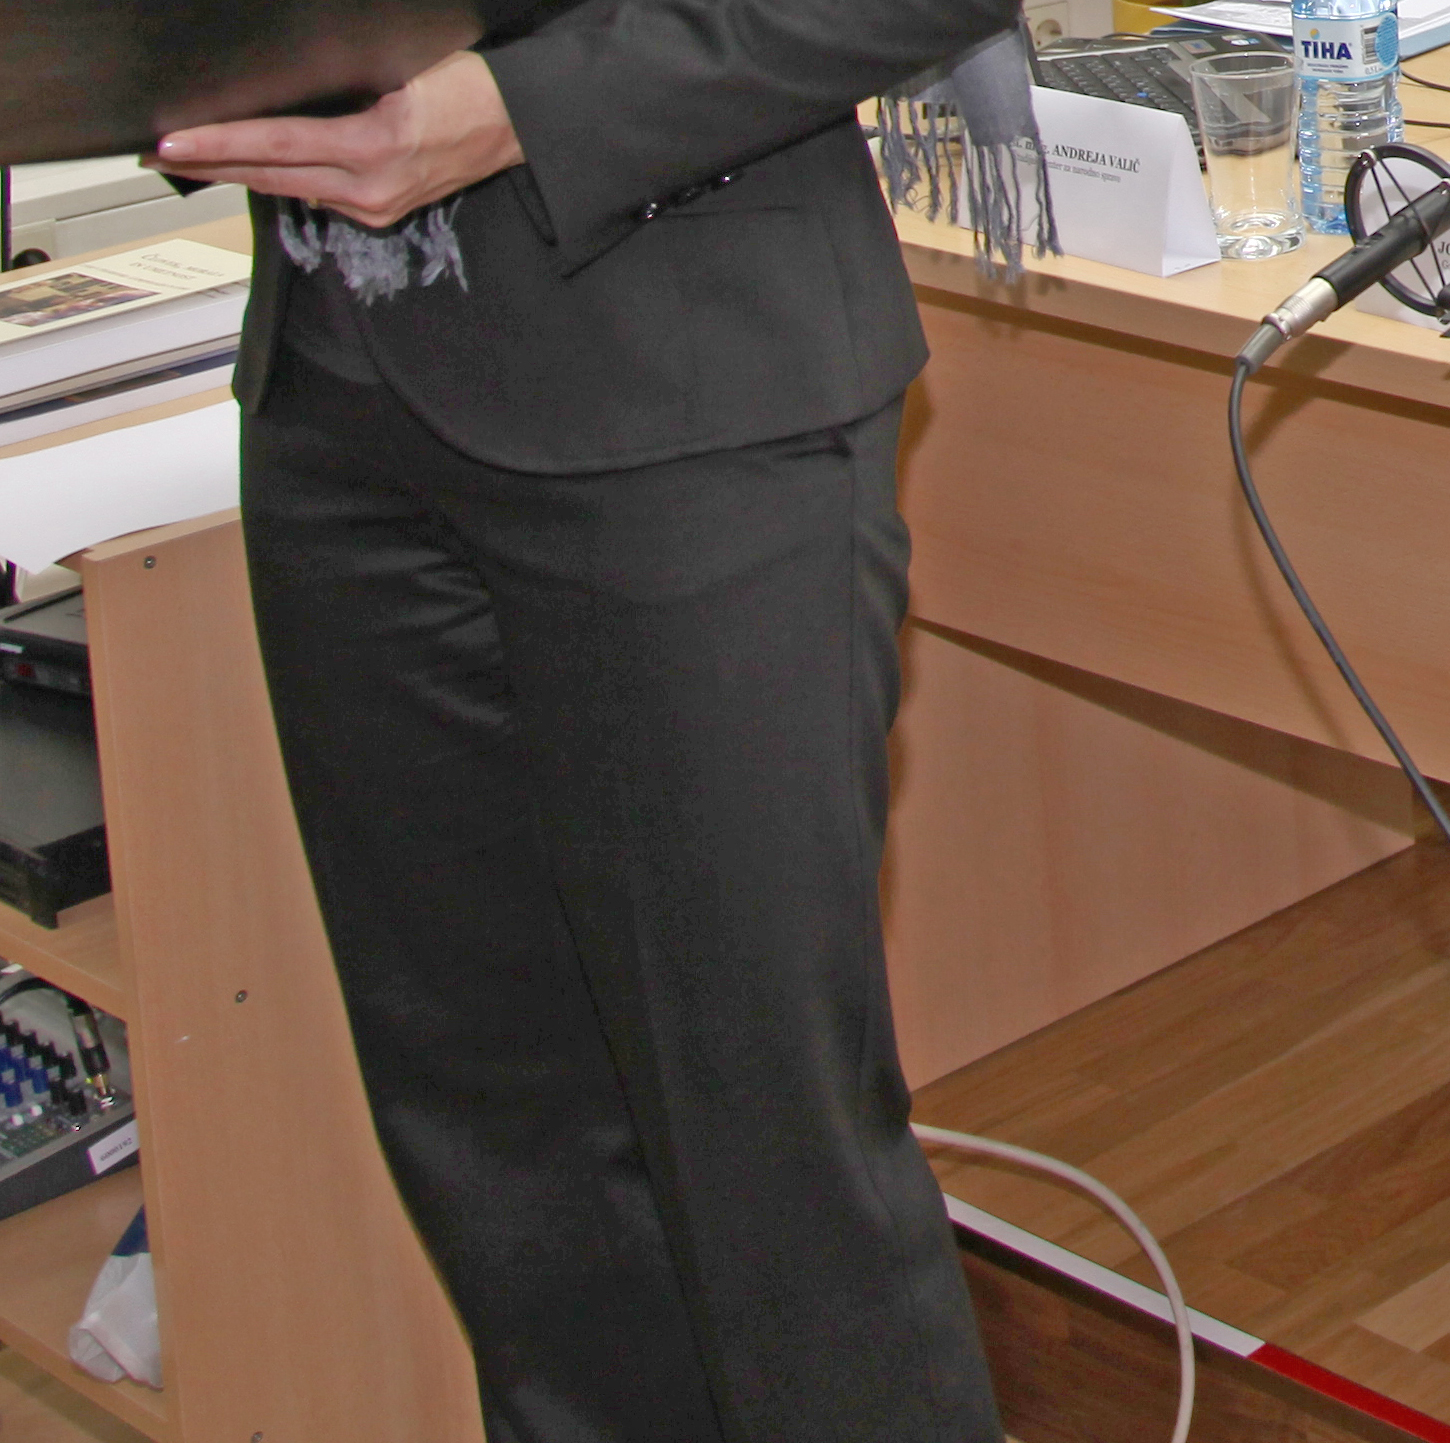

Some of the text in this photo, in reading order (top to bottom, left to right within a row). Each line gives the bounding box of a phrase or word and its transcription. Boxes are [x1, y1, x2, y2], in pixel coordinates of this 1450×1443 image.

[1301, 41, 1353, 60] TIHA
[1052, 144, 1106, 166] ANDREJA
[1109, 155, 1141, 174] VALIČ
